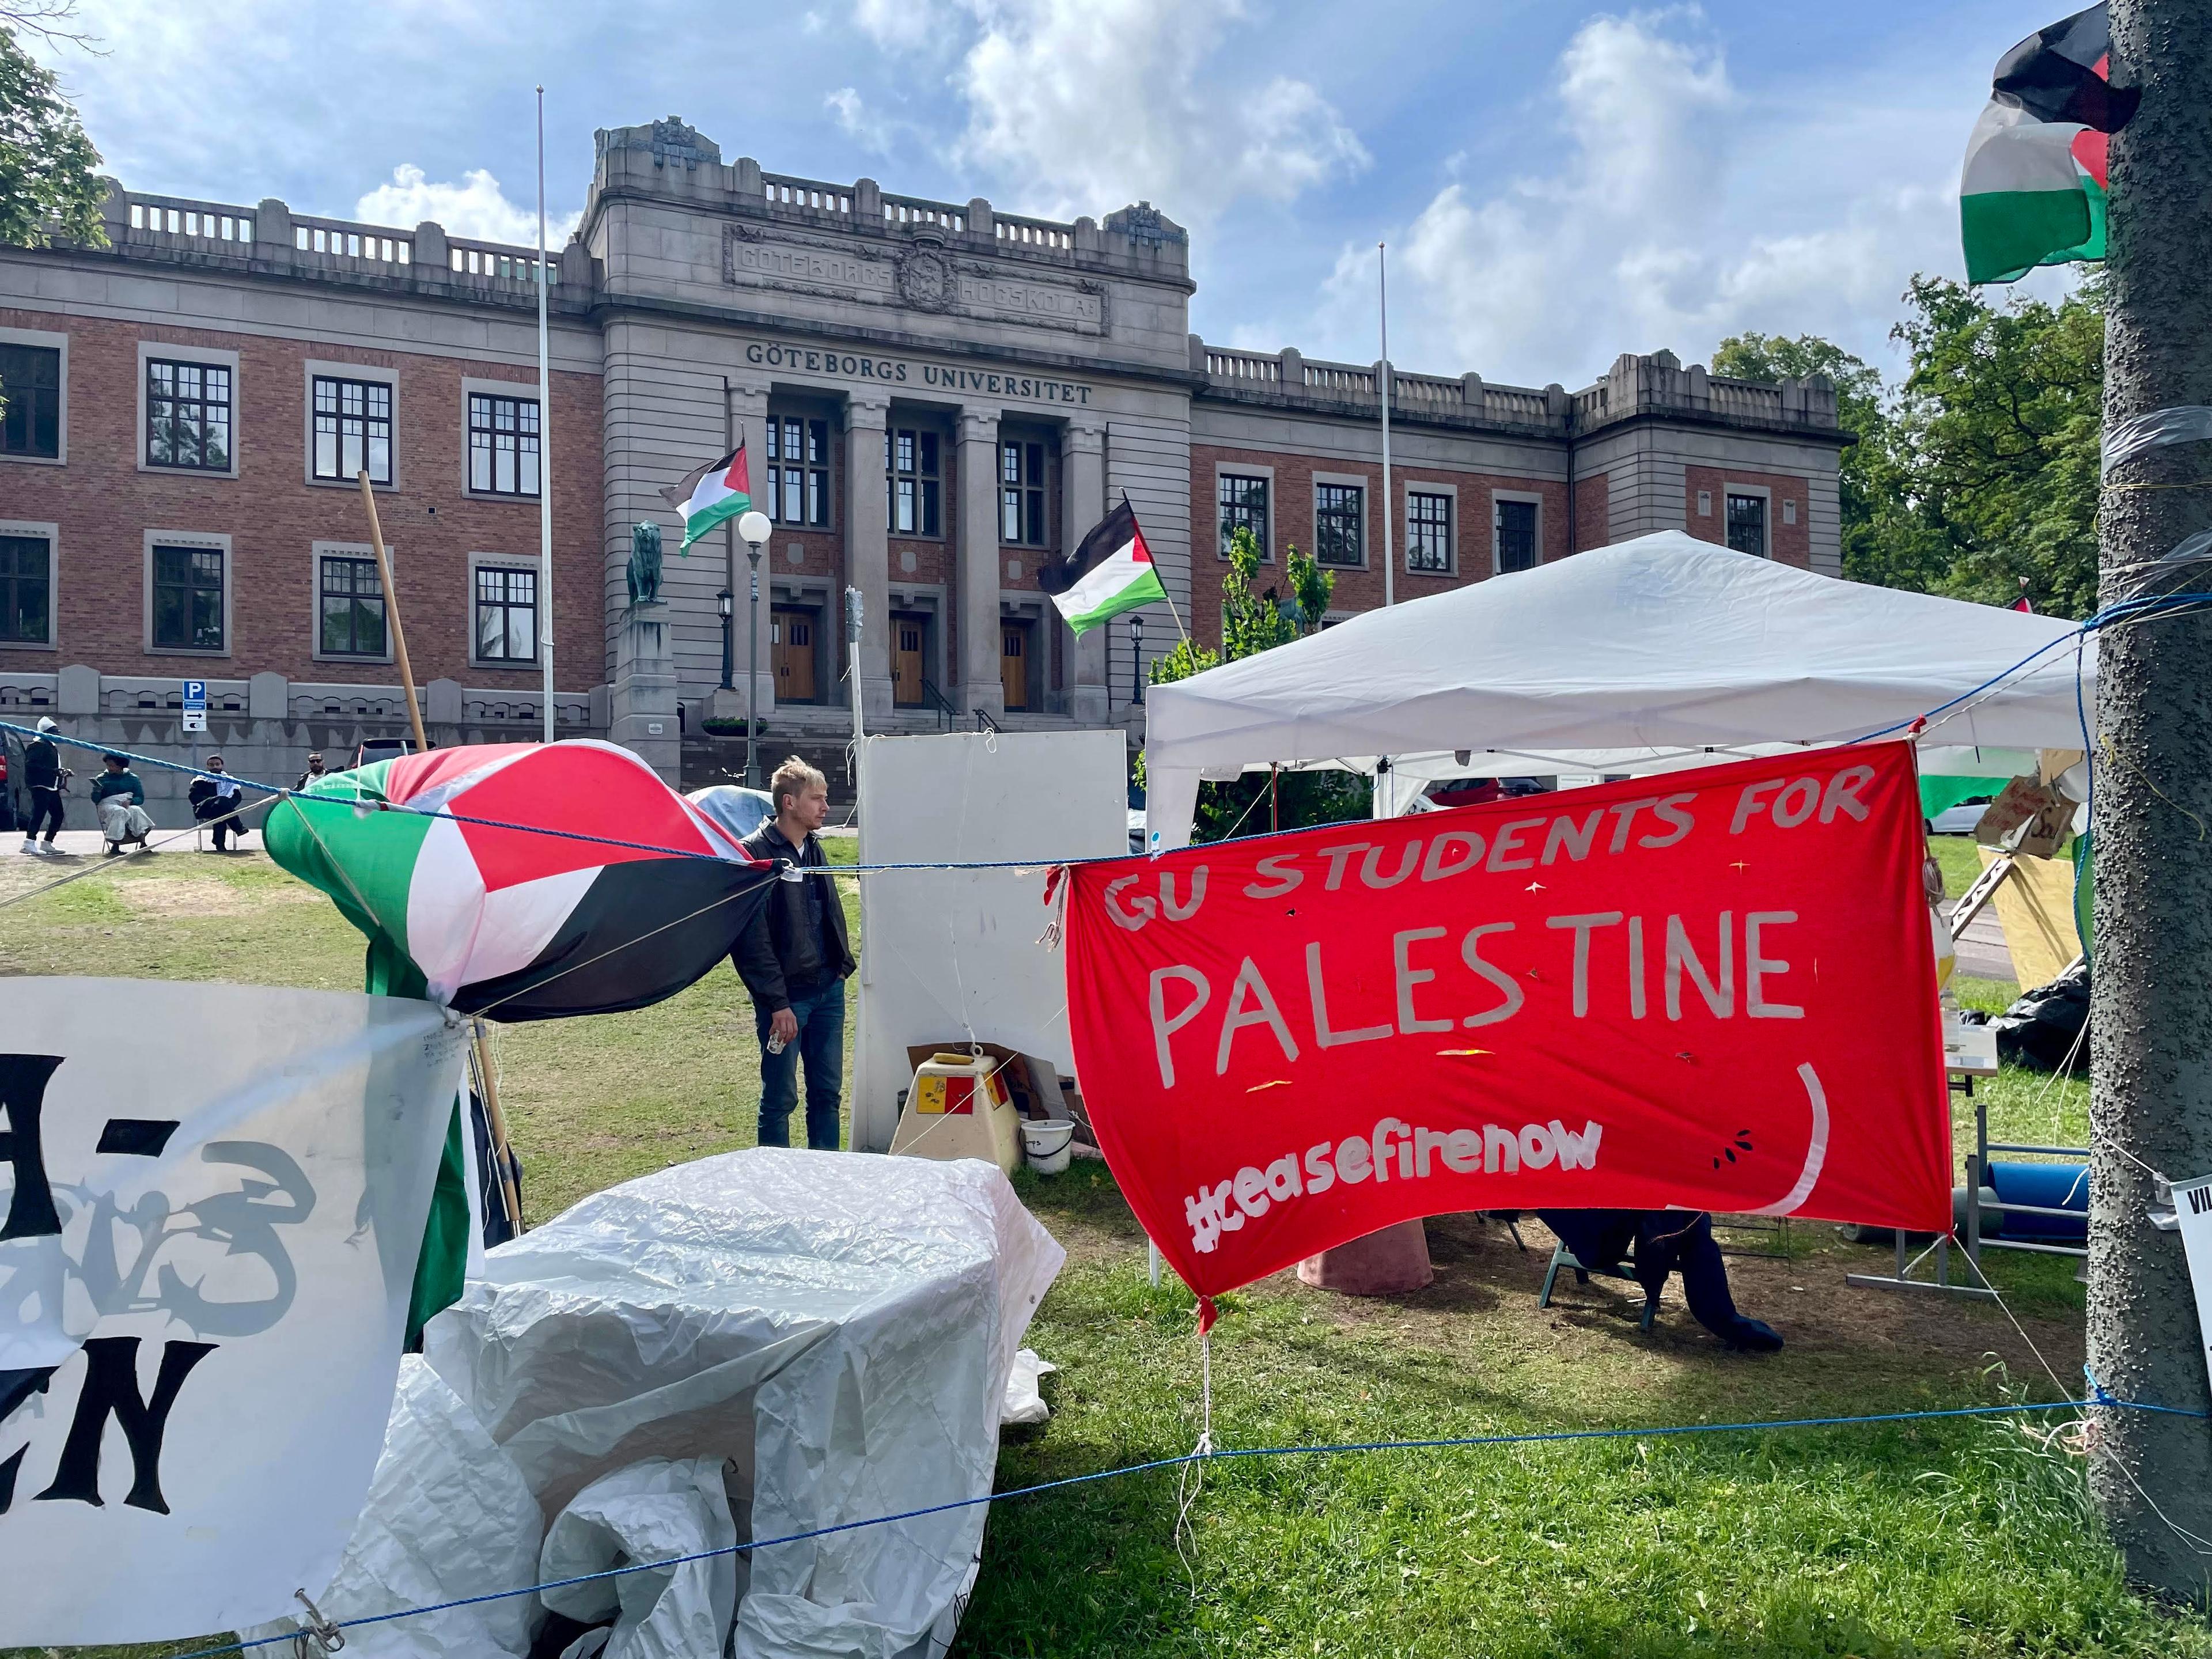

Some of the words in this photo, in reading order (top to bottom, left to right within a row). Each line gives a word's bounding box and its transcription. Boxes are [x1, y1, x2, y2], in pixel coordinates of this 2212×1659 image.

[747, 342, 906, 381] GÖTEBORGS
[924, 366, 1092, 403] UNIVERSITET
[189, 683, 202, 698] P
[1104, 864, 1209, 931] GU
[1244, 793, 1696, 900] STUDENTS
[1730, 765, 1875, 834] FOR
[1149, 910, 1804, 1089] PALESTINE
[1184, 1117, 1603, 1253] #ceasefirenow
